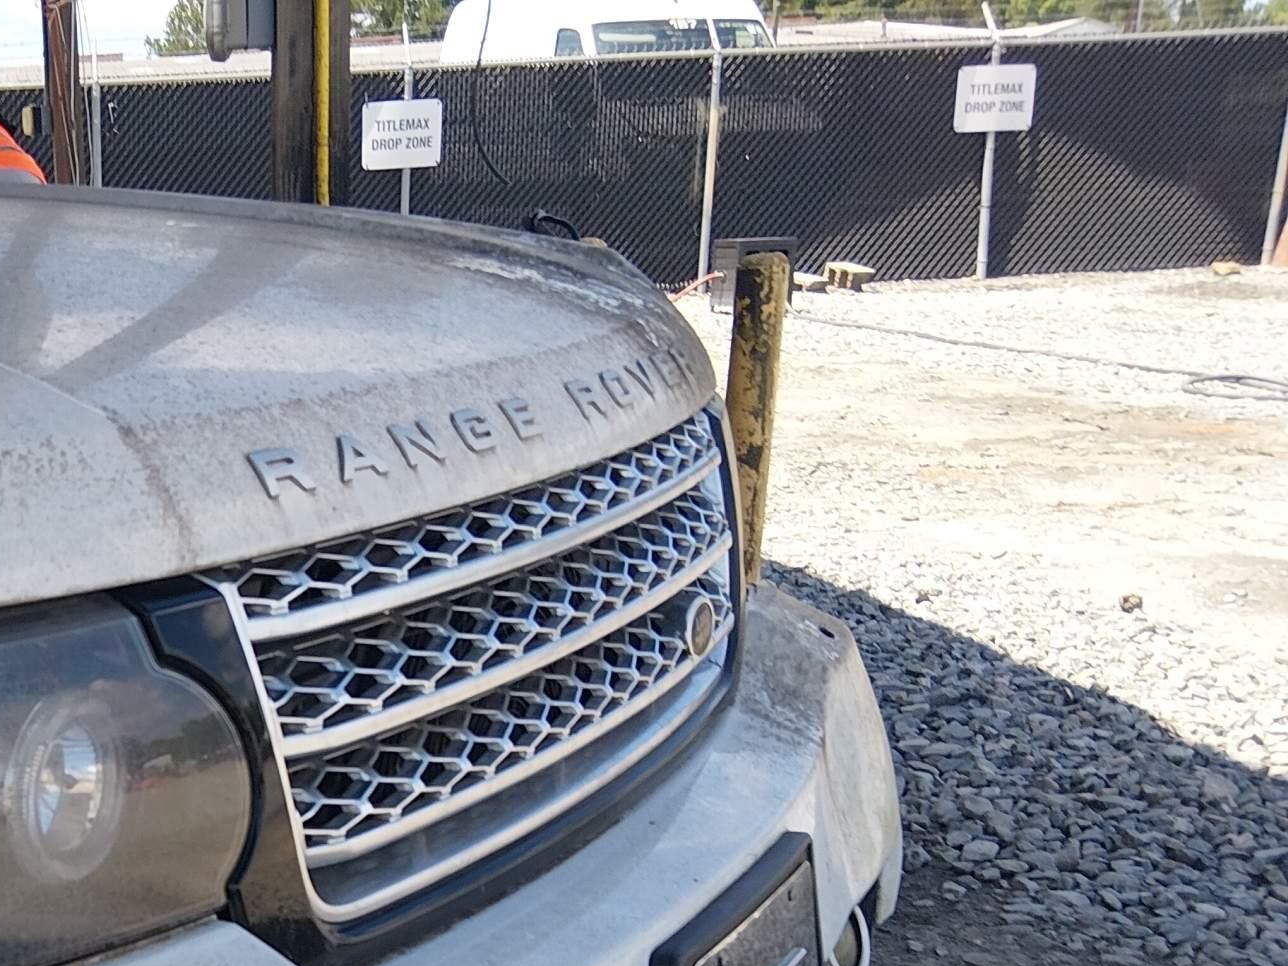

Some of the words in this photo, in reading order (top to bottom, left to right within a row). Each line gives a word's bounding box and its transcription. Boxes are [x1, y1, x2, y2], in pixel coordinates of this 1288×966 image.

[970, 83, 1023, 96] TITLEMAX
[964, 101, 996, 113] DROP
[999, 100, 1025, 112] ZONE
[375, 118, 431, 132] TITLEMAX
[372, 138, 402, 151] DROP
[406, 136, 432, 149] ZONE
[245, 396, 544, 500] RANGE
